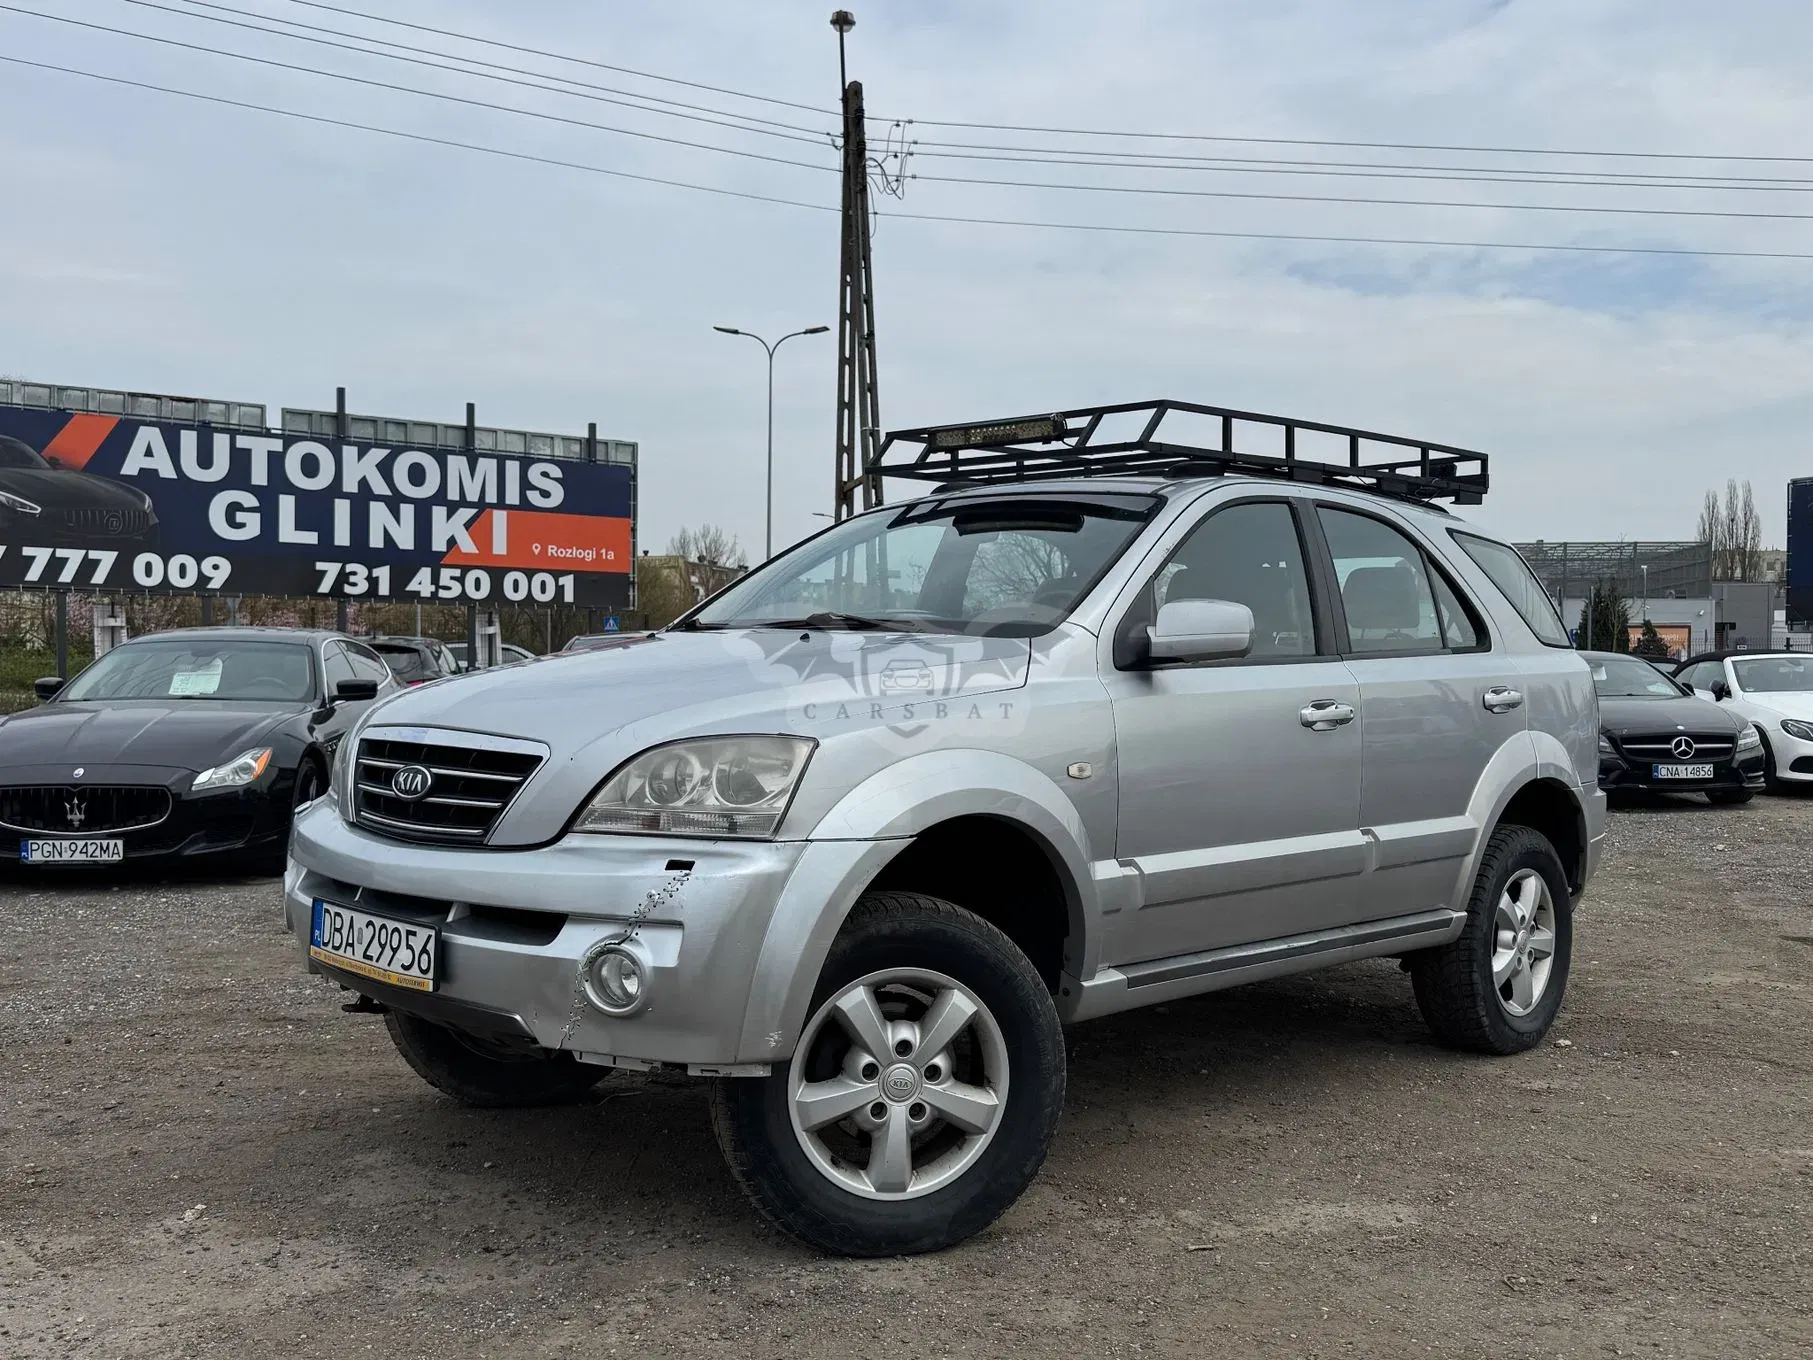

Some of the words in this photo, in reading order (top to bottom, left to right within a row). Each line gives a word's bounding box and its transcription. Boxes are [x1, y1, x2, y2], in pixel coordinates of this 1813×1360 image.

[120, 425, 565, 508] AUTOKOMIS
[208, 490, 507, 555] GLINKI
[22, 546, 119, 585] 777
[133, 552, 232, 589] 009
[600, 547, 615, 560] 1a
[315, 561, 390, 596] 731
[405, 566, 491, 600] 450
[503, 570, 575, 603] 001
[397, 772, 422, 792] KIA
[1659, 766, 1680, 777] CNA
[1684, 766, 1713, 777] 14856
[30, 842, 63, 859] PGN
[68, 841, 122, 859] 942MA
[321, 907, 356, 957] DBA
[362, 919, 433, 976] 29956
[893, 1080, 909, 1088] KIA
